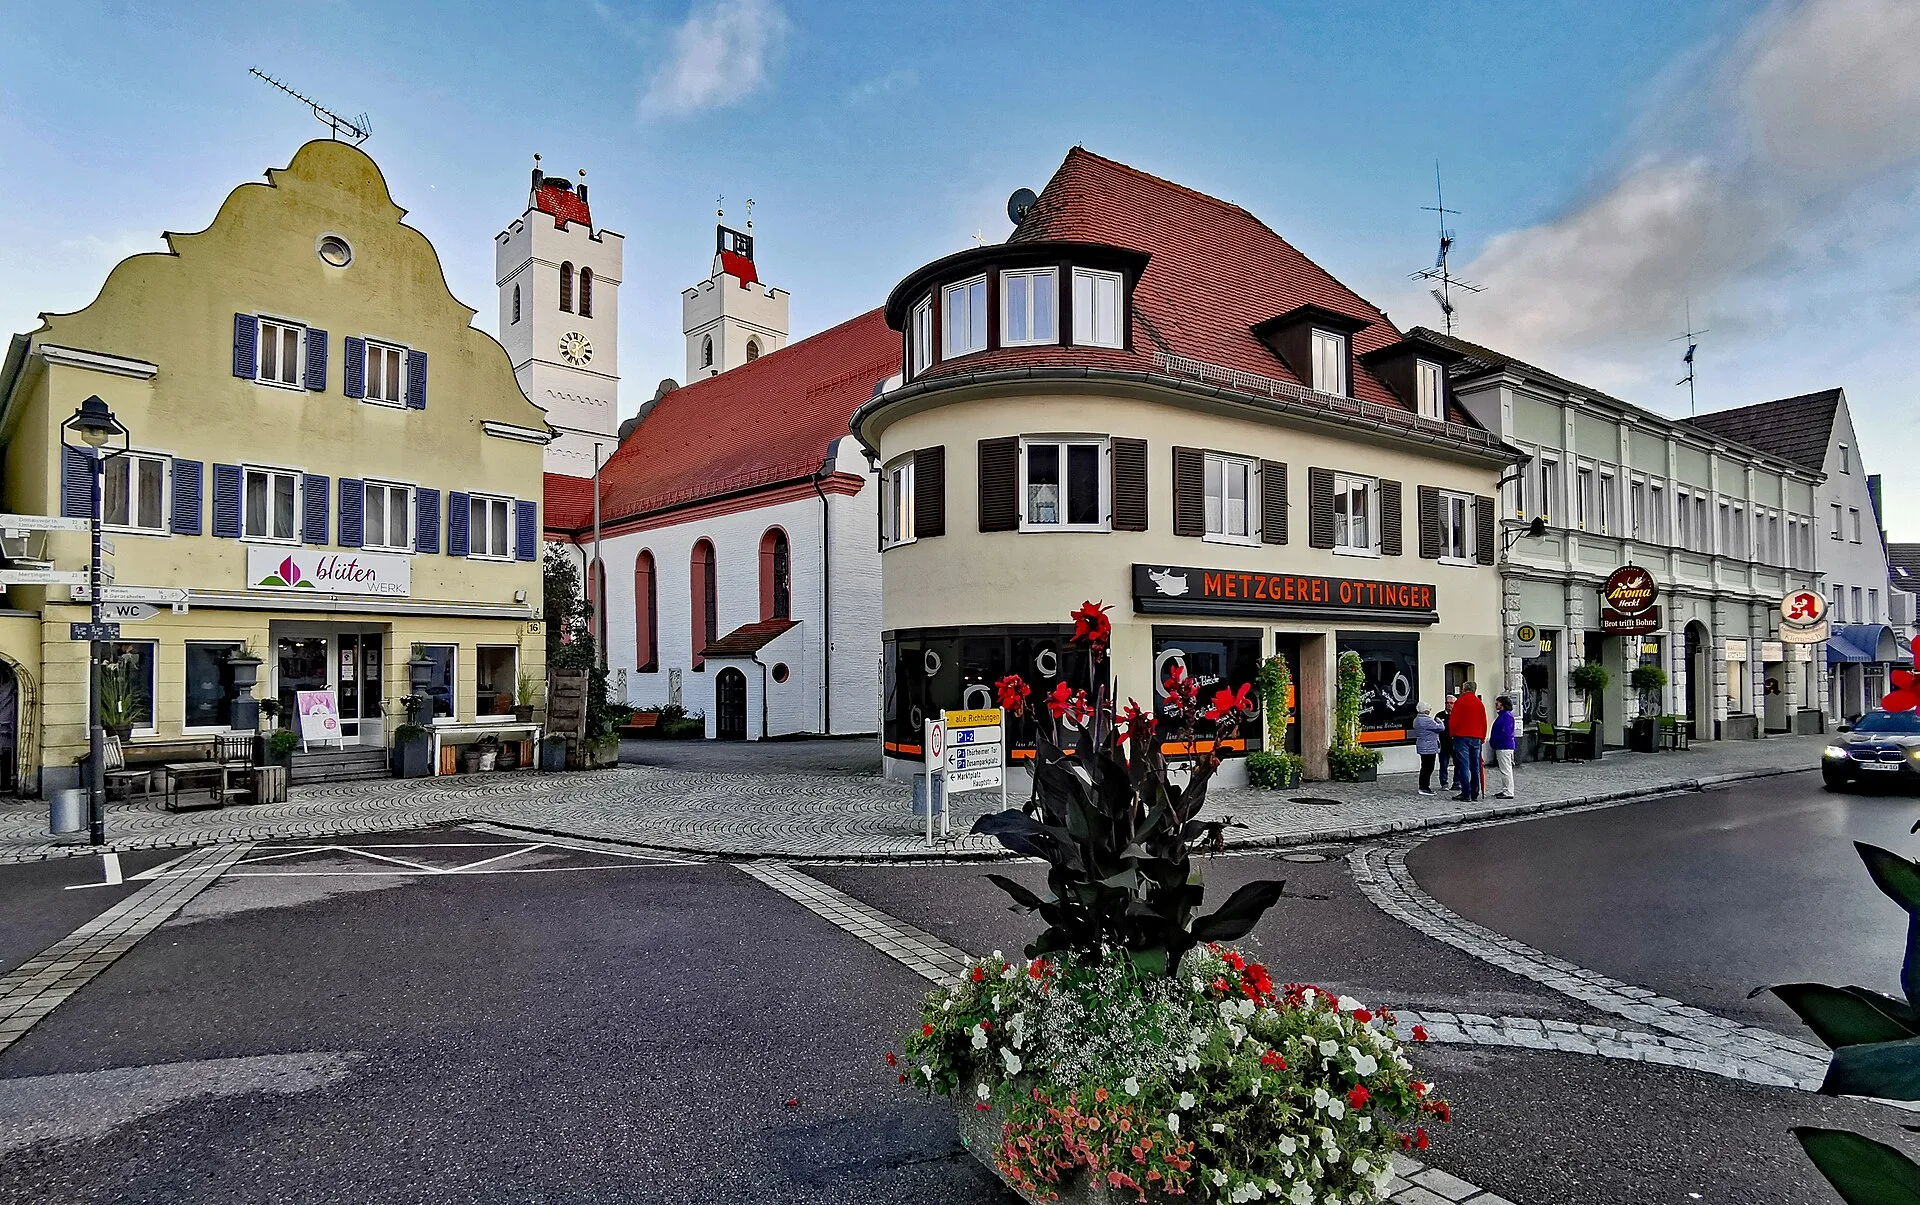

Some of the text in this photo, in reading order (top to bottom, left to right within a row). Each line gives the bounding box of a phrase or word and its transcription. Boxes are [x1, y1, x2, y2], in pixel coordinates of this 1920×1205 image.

[316, 555, 376, 582] blüten
[1204, 572, 1431, 607] METZGEREI OTTINGER
[1608, 587, 1651, 600] Aroma
[1618, 599, 1640, 607] Heckl
[116, 606, 140, 616] WC
[1619, 619, 1635, 627] trifft
[1635, 618, 1657, 626] Bohne
[529, 623, 539, 632] 16
[1522, 628, 1531, 639] H
[955, 714, 1000, 723] alle Richtungen
[956, 771, 981, 780] Marktplatz
